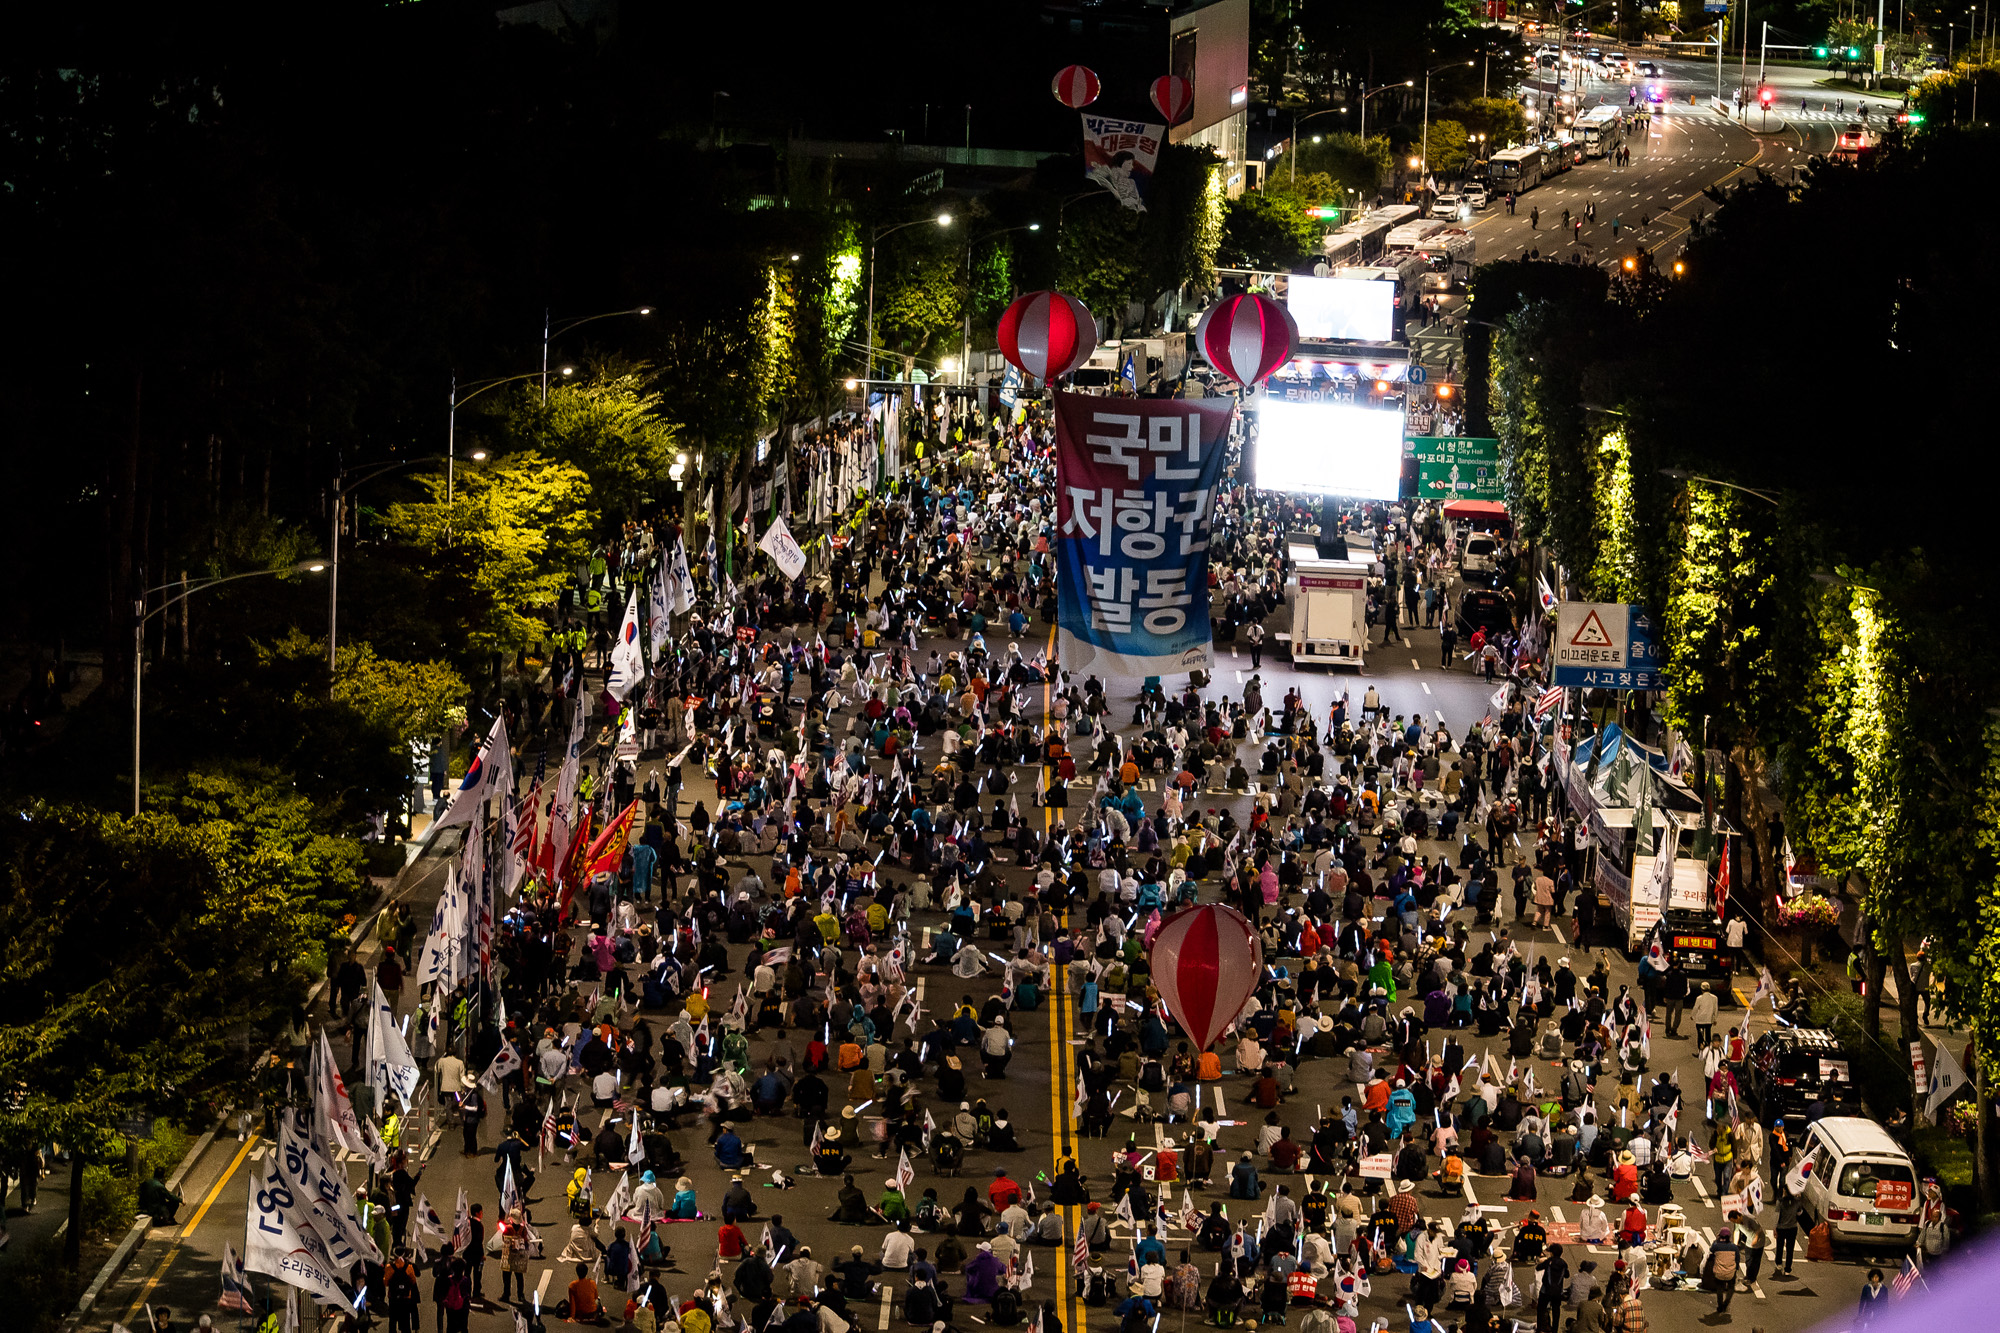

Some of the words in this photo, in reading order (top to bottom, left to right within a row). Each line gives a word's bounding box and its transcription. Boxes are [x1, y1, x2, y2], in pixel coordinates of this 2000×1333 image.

[1085, 118, 1146, 136] 박근혜
[1101, 134, 1158, 156] 대통령
[1086, 412, 1201, 481] 국민
[1436, 441, 1456, 453] 시청
[1417, 453, 1455, 464] 반포대교
[1446, 491, 1458, 499] 350
[1060, 484, 1217, 560] 저항권
[1083, 566, 1193, 635] 발동
[1561, 649, 1621, 664] 미끄러운도로
[279, 1256, 331, 1289] 우리공화당
